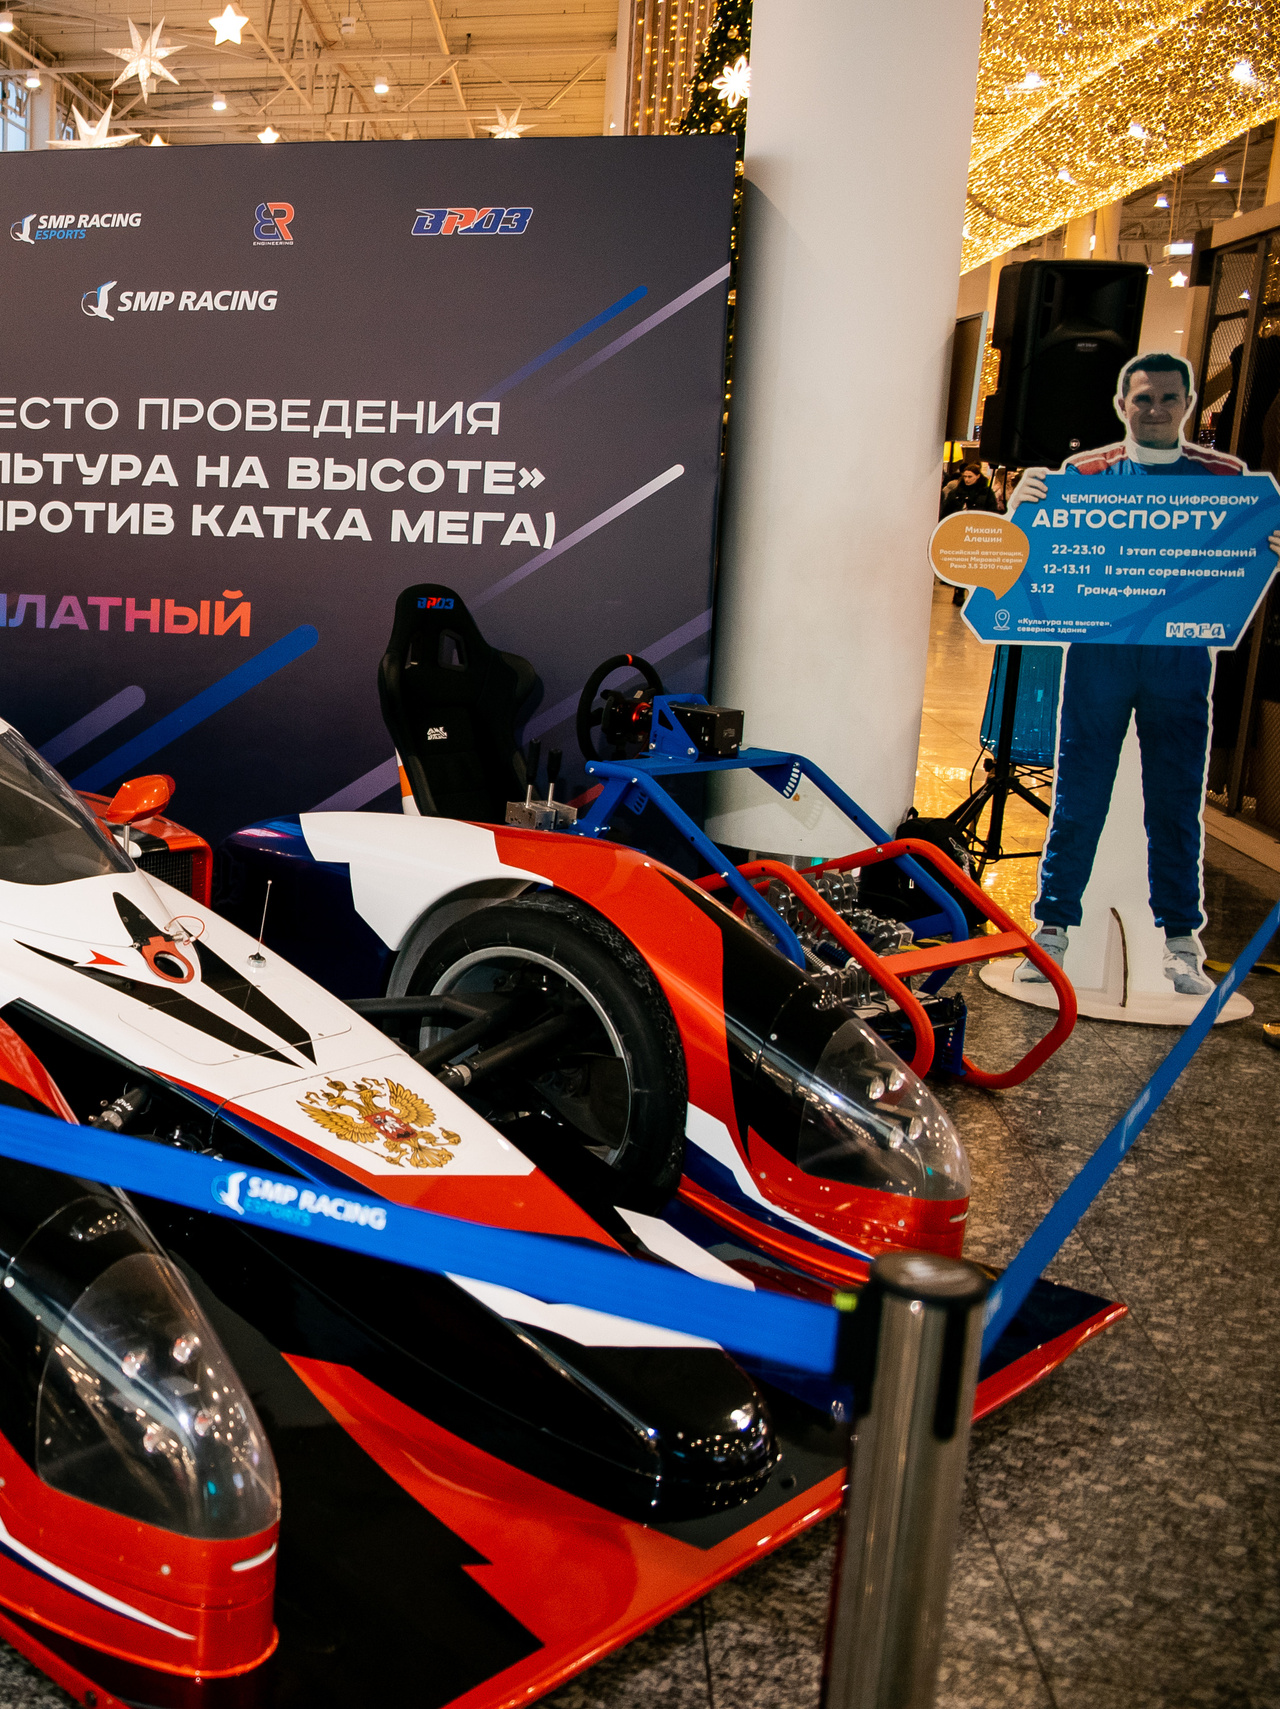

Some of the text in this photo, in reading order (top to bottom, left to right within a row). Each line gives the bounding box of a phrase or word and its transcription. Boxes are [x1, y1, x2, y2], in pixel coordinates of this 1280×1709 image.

[37, 212, 142, 229] SMP RACING
[35, 229, 87, 240] ESPORTS
[117, 290, 278, 311] SMP RACING
[138, 397, 501, 439] ПРОВЕДЕНИЯ
[196, 455, 270, 489] НА
[287, 456, 546, 495] ВЫСОТЕ»
[1061, 494, 1259, 506] ЧЕМПИОНАТ ПО ЦИФРОВОМУ
[1032, 509, 1227, 530] АВТОСПОРТУ
[191, 504, 373, 542] КАТКА
[390, 508, 556, 550] МЕГА)
[965, 526, 1002, 534] Михаил
[964, 535, 1002, 543] Алешин
[1051, 544, 1105, 555] 22-23.10
[1126, 547, 1157, 557] этап
[1159, 547, 1257, 558] соревнований
[1043, 564, 1091, 575] 12-13.11
[1115, 567, 1145, 576] этап
[1148, 567, 1245, 578] соревнований
[1030, 583, 1054, 594] 3.12
[1077, 584, 1166, 597] Гранд-финал
[1017, 618, 1061, 627] «Культура
[1075, 619, 1112, 628] высоте»,
[1017, 626, 1087, 635] северное здание
[246, 1176, 388, 1231] SMP RACING
[243, 1196, 312, 1227] ESPORTS
